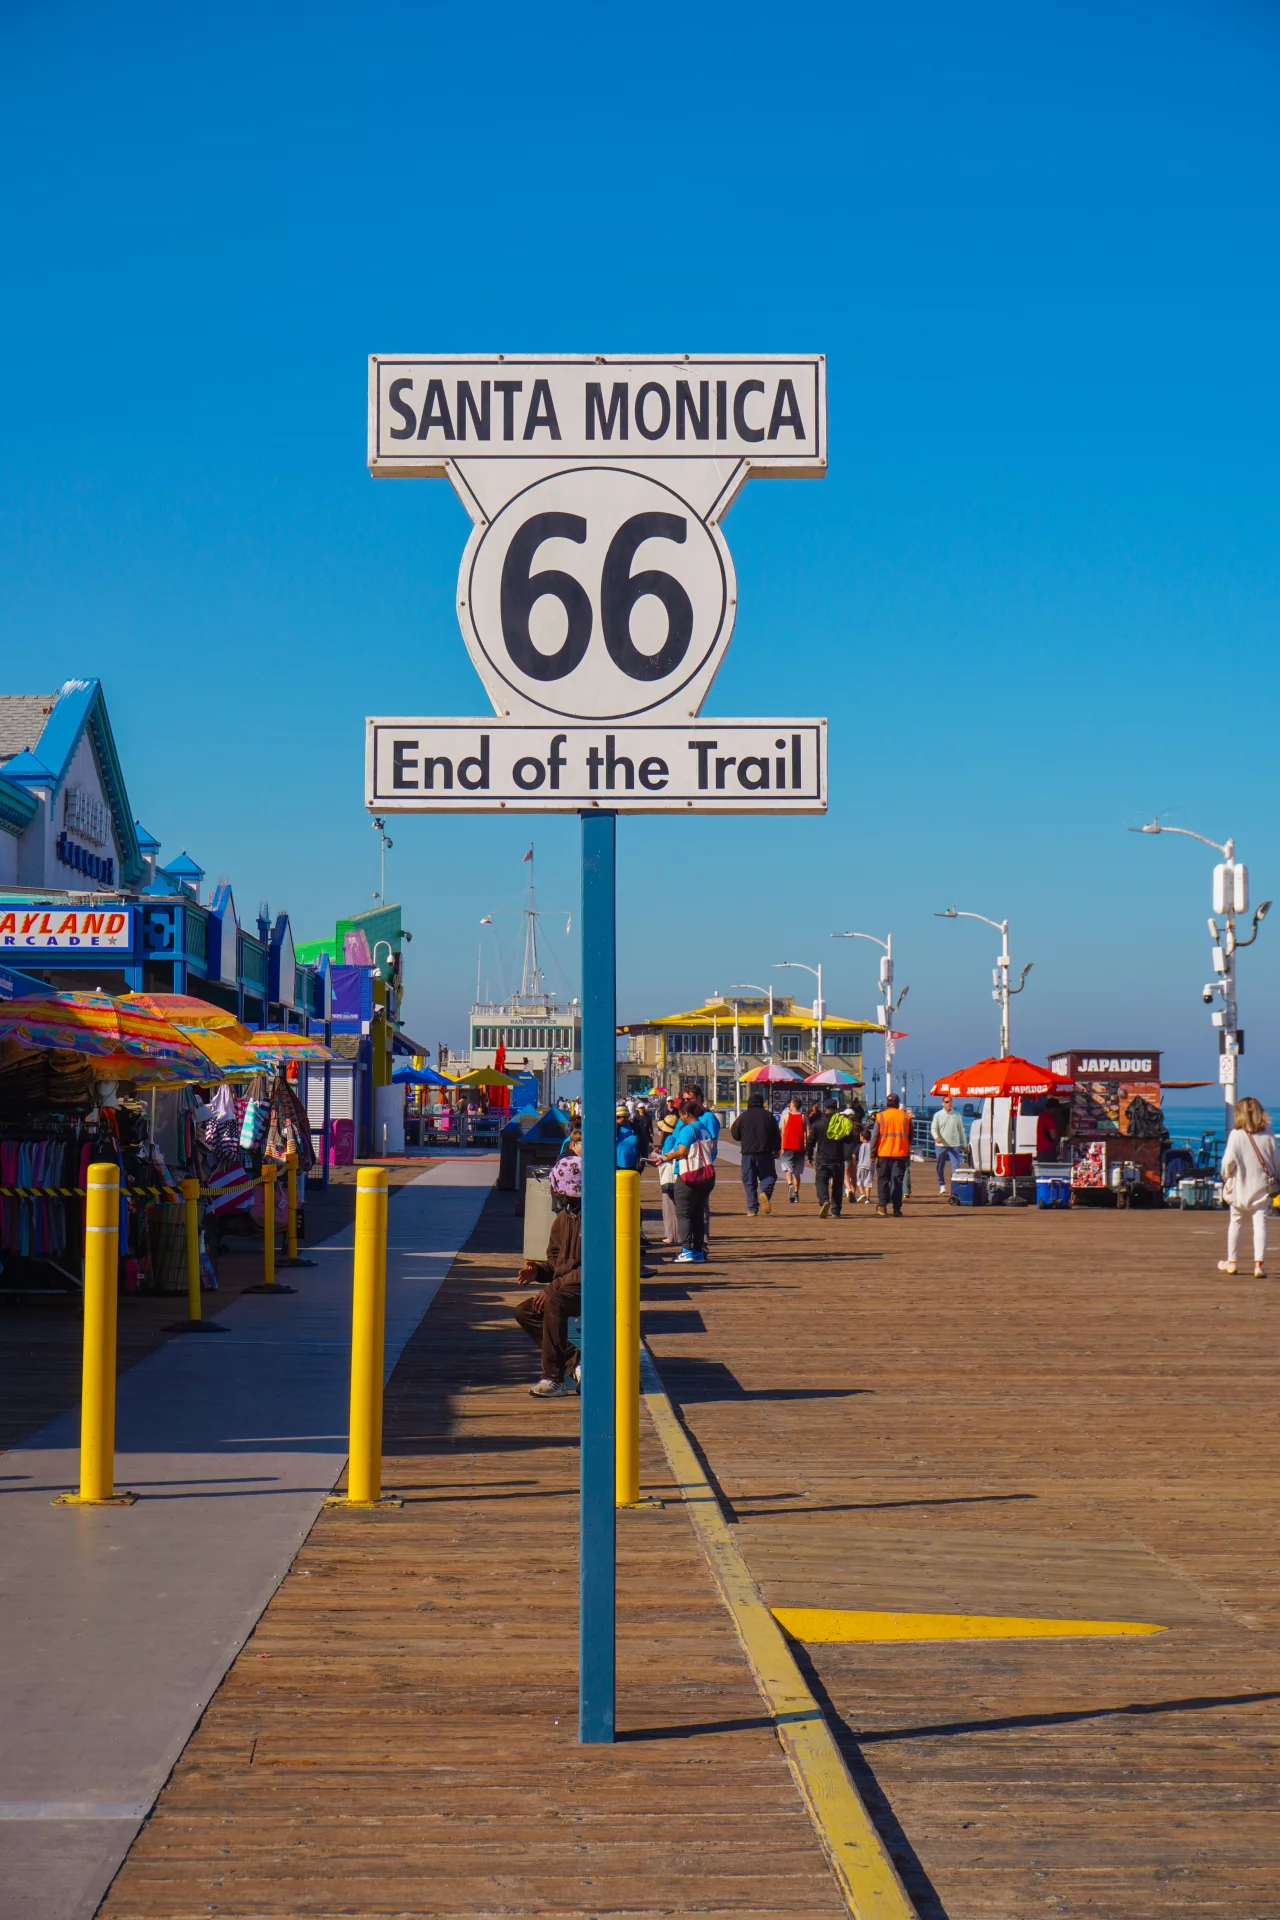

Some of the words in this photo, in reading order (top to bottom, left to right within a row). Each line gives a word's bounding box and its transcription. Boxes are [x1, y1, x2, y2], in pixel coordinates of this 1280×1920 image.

[388, 378, 562, 441] SANTA
[585, 379, 806, 443] MONICA
[500, 511, 694, 682] 66
[393, 734, 490, 790] End
[512, 734, 567, 791] of
[585, 734, 669, 791] the
[688, 734, 802, 791] Trail
[1078, 1058, 1152, 1073] JAPADOG
